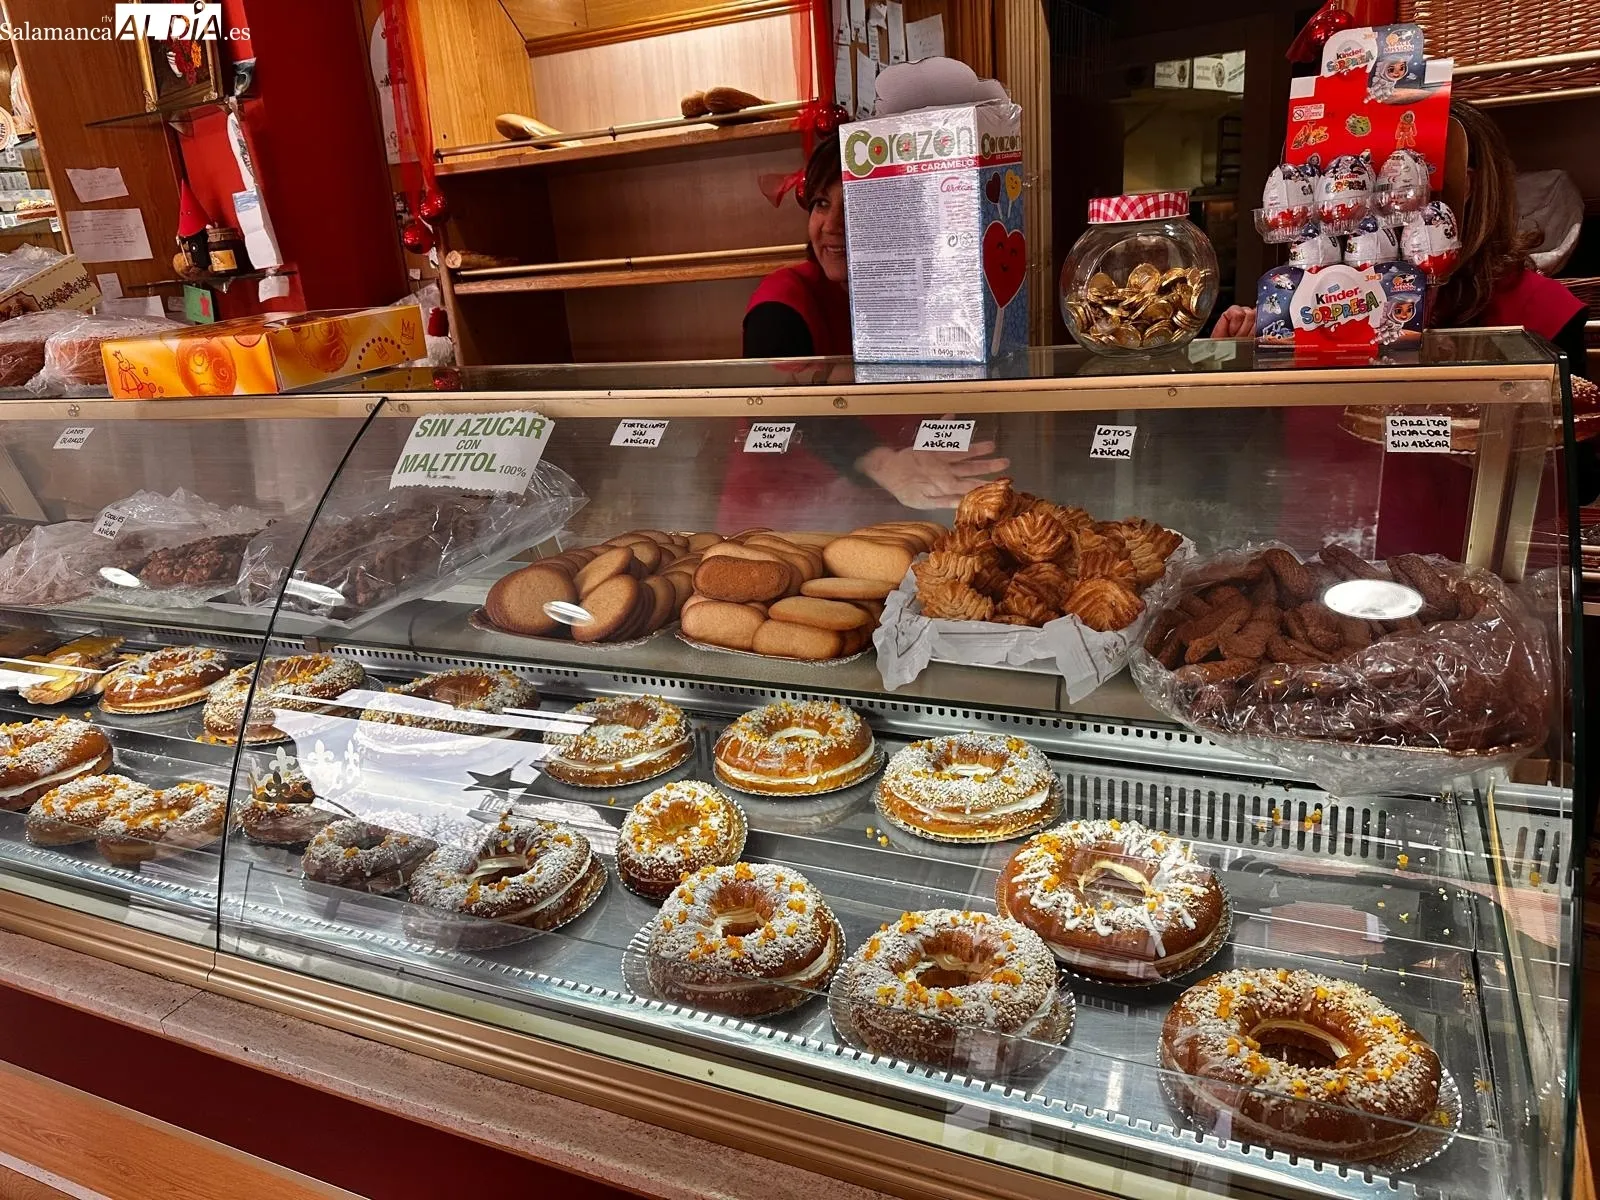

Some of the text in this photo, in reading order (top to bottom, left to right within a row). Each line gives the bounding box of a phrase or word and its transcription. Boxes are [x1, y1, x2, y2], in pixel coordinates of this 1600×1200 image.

[907, 158, 975, 173] DE CARAMELO
[1300, 291, 1380, 324] SORPRESA
[922, 422, 972, 430] MANINAS
[1390, 418, 1448, 427] BARRITAS
[415, 417, 546, 439] SIN AZUCAR
[753, 425, 791, 433] LENGUAS
[1097, 427, 1132, 437] LOTOS
[1392, 429, 1450, 437] HOJALDRE
[456, 439, 481, 450] CON
[922, 440, 960, 449] AZÚCAR
[1102, 439, 1119, 447] SIN
[1390, 439, 1450, 448] SIN AZÚCAR
[1091, 447, 1131, 457] AZÚCAR
[398, 452, 527, 478] MALTITOL 100%
